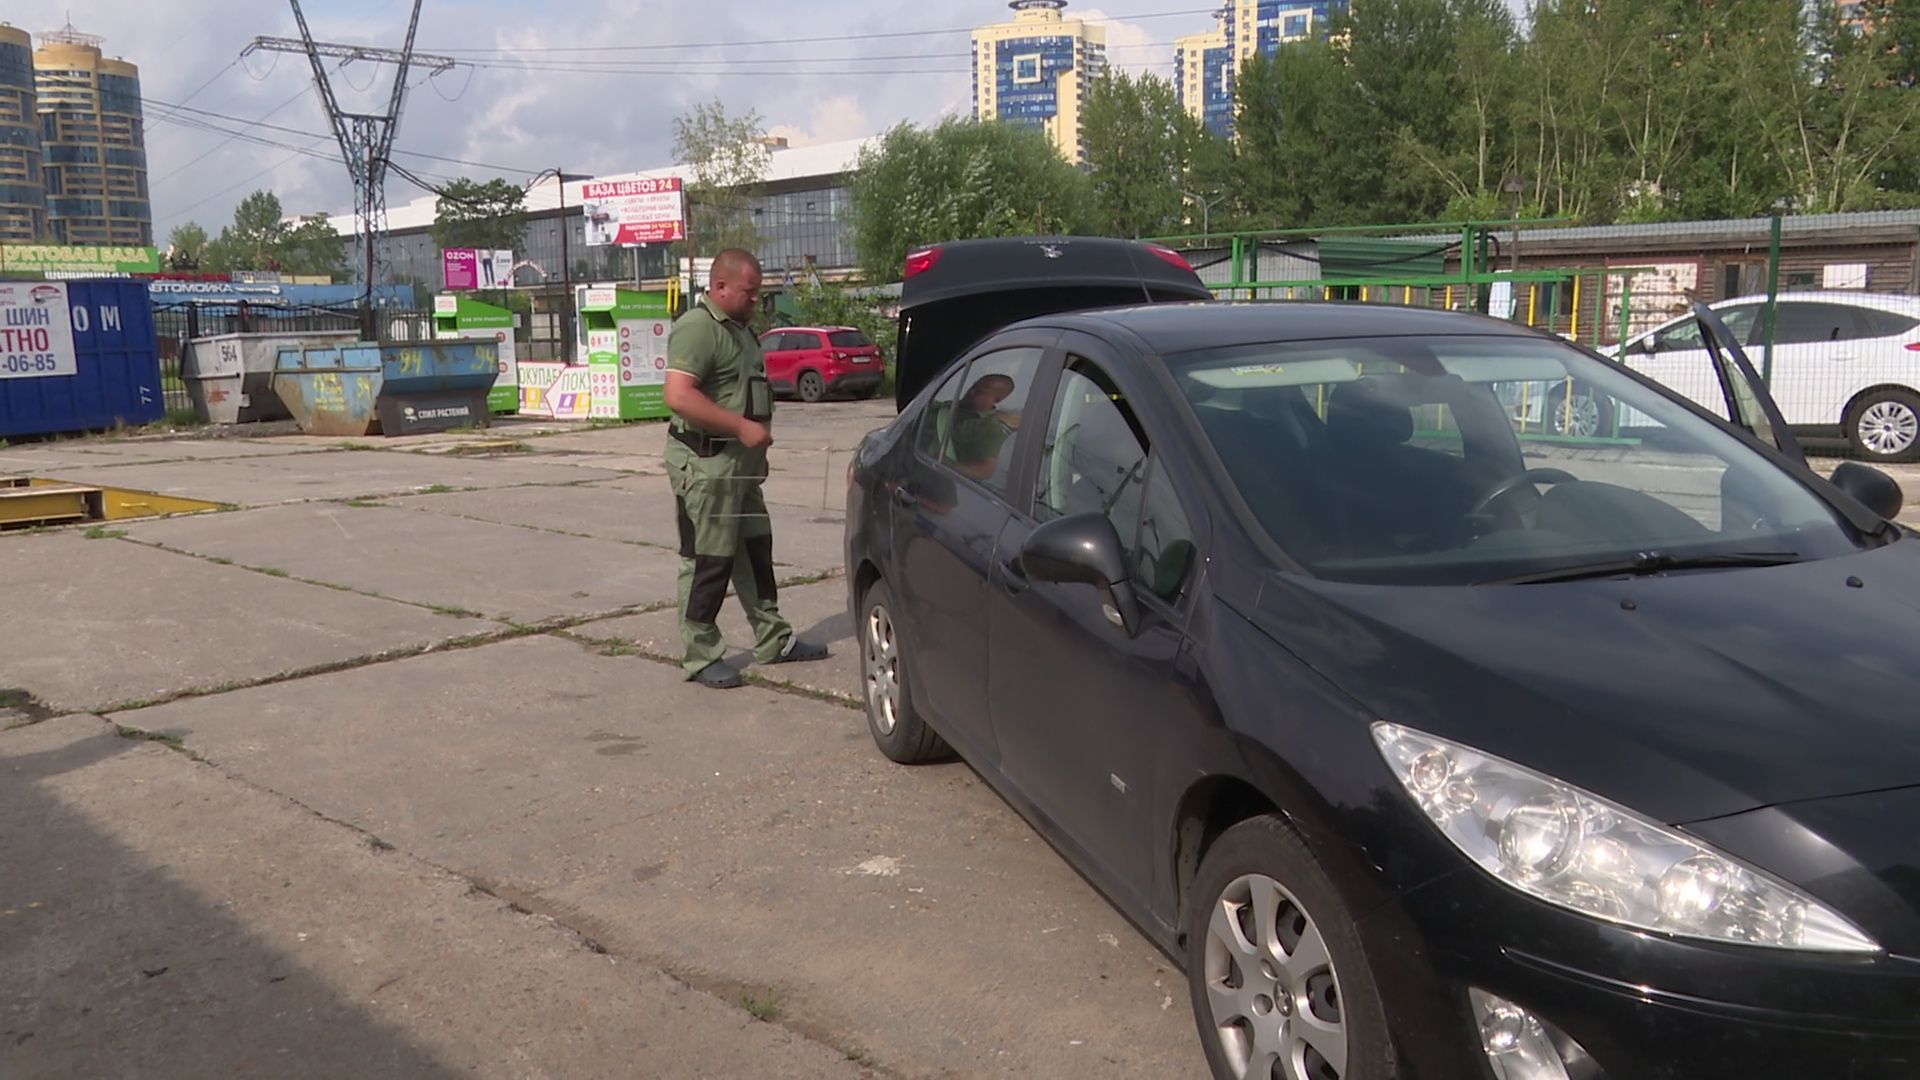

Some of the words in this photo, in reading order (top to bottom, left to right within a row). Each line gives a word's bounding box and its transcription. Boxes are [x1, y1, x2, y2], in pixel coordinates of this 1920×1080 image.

[588, 185, 616, 197] БАЗА
[617, 181, 657, 196] ЦВЕТОВ
[658, 179, 673, 191] 24
[101, 247, 149, 263] БАЗА
[446, 251, 474, 260] OZON
[6, 308, 49, 326] ШИН
[0, 328, 49, 352] ТНО
[222, 345, 238, 362] 564
[519, 367, 561, 385] ОКУПАЕ
[561, 371, 592, 392] ПОК
[139, 384, 153, 405] 77
[418, 409, 437, 419] СПИЛ
[437, 405, 469, 417] РАСТЕНИЙ
